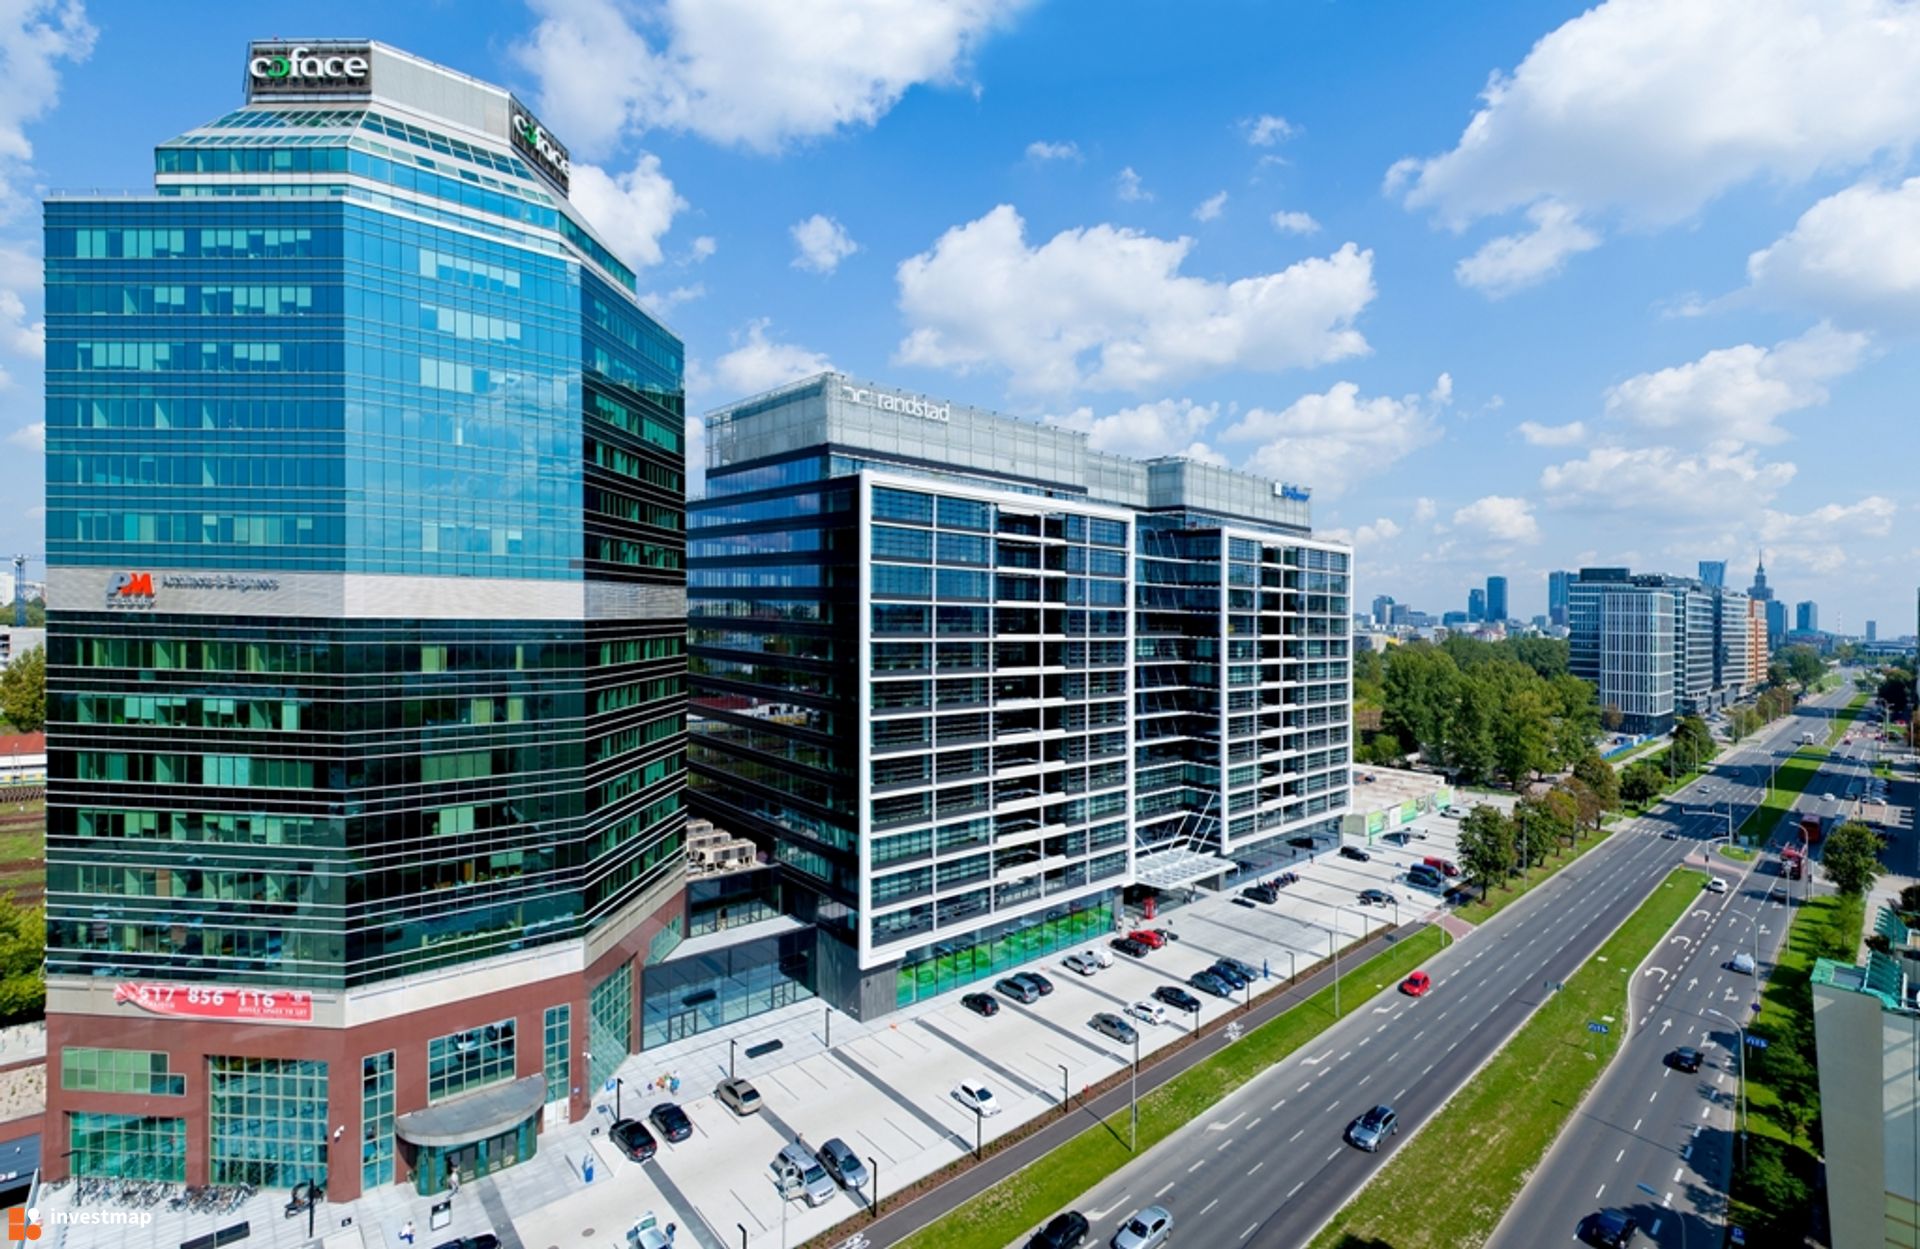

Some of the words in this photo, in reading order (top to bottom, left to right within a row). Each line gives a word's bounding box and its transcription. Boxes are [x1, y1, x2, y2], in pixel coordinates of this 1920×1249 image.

[250, 46, 369, 79] coface
[513, 114, 570, 177] coface
[877, 393, 950, 422] randstad
[106, 572, 156, 597] PM
[188, 988, 225, 1006] 856
[238, 990, 276, 1007] 116
